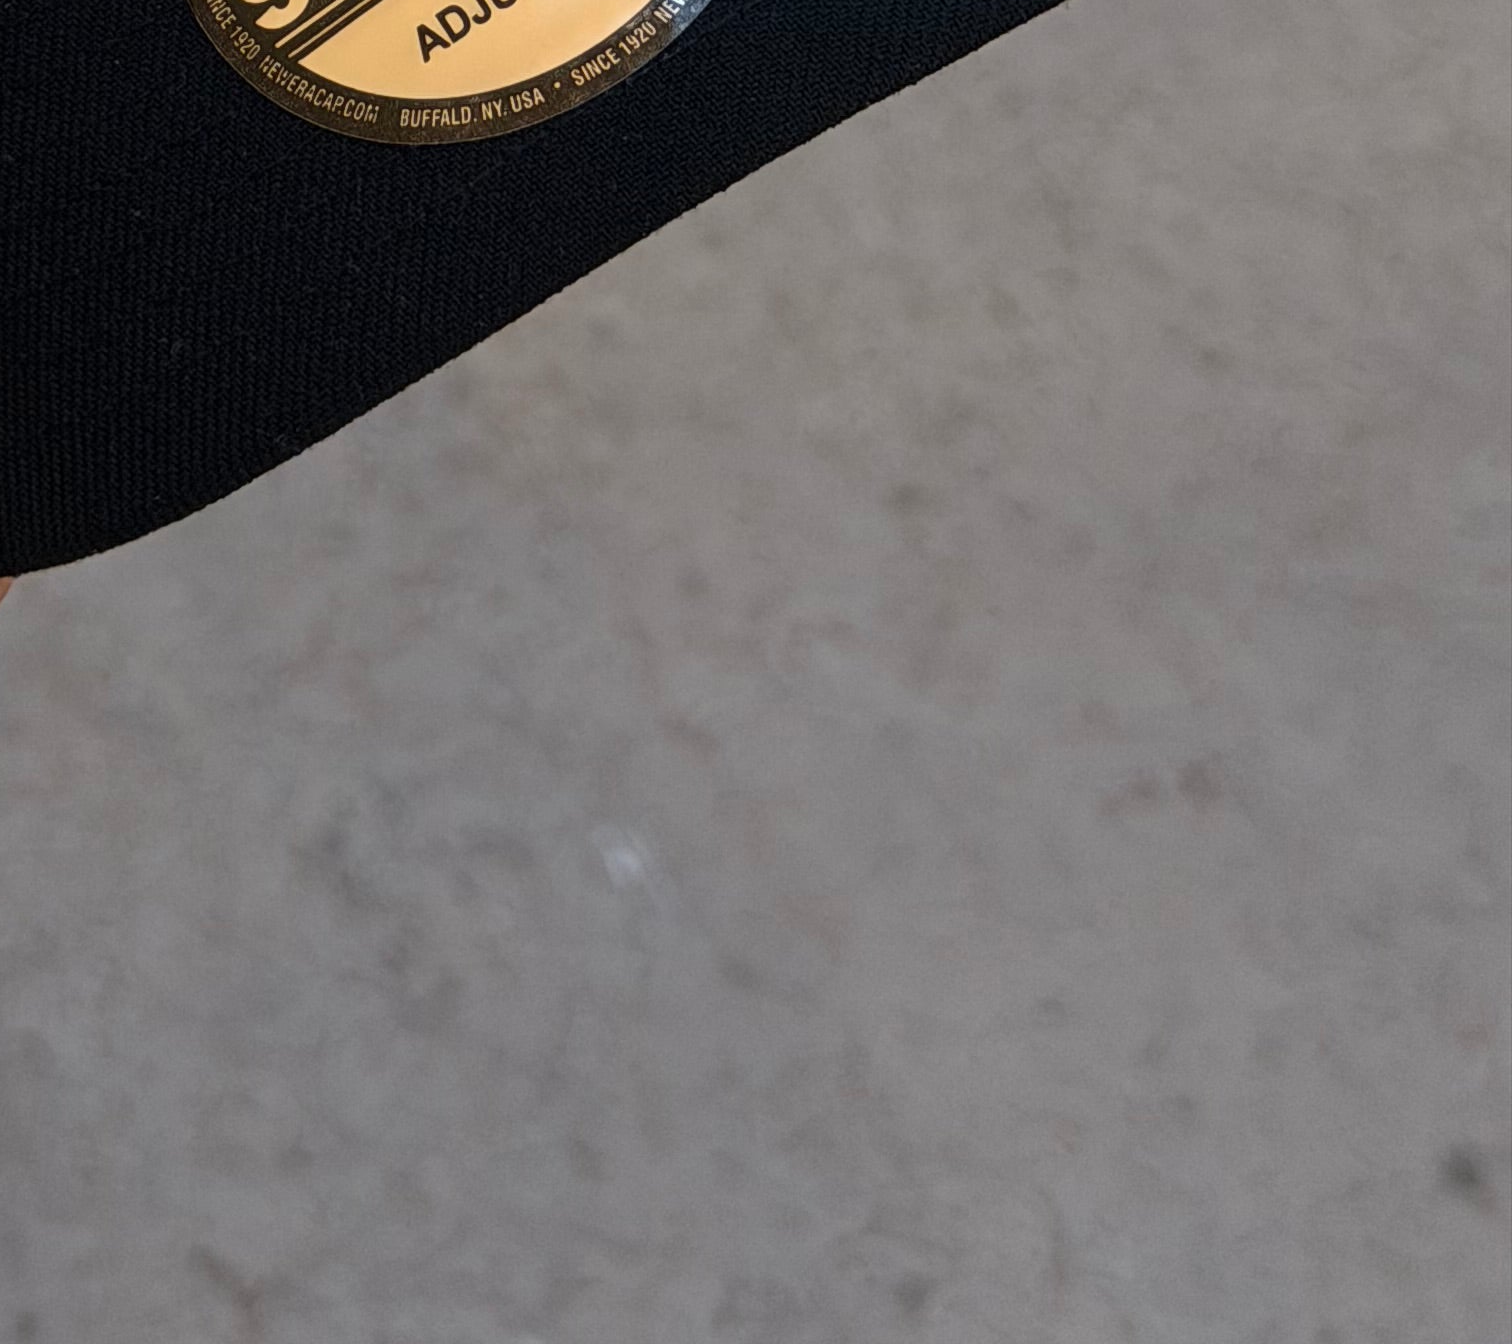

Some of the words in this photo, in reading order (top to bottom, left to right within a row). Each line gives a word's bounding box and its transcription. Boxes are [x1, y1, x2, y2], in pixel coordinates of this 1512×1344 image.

[229, 25, 261, 60] 1920
[259, 55, 380, 124] NEWERACAP.COM
[510, 87, 545, 112] USA
[570, 48, 621, 87] SINCE
[618, 22, 657, 56] 1920
